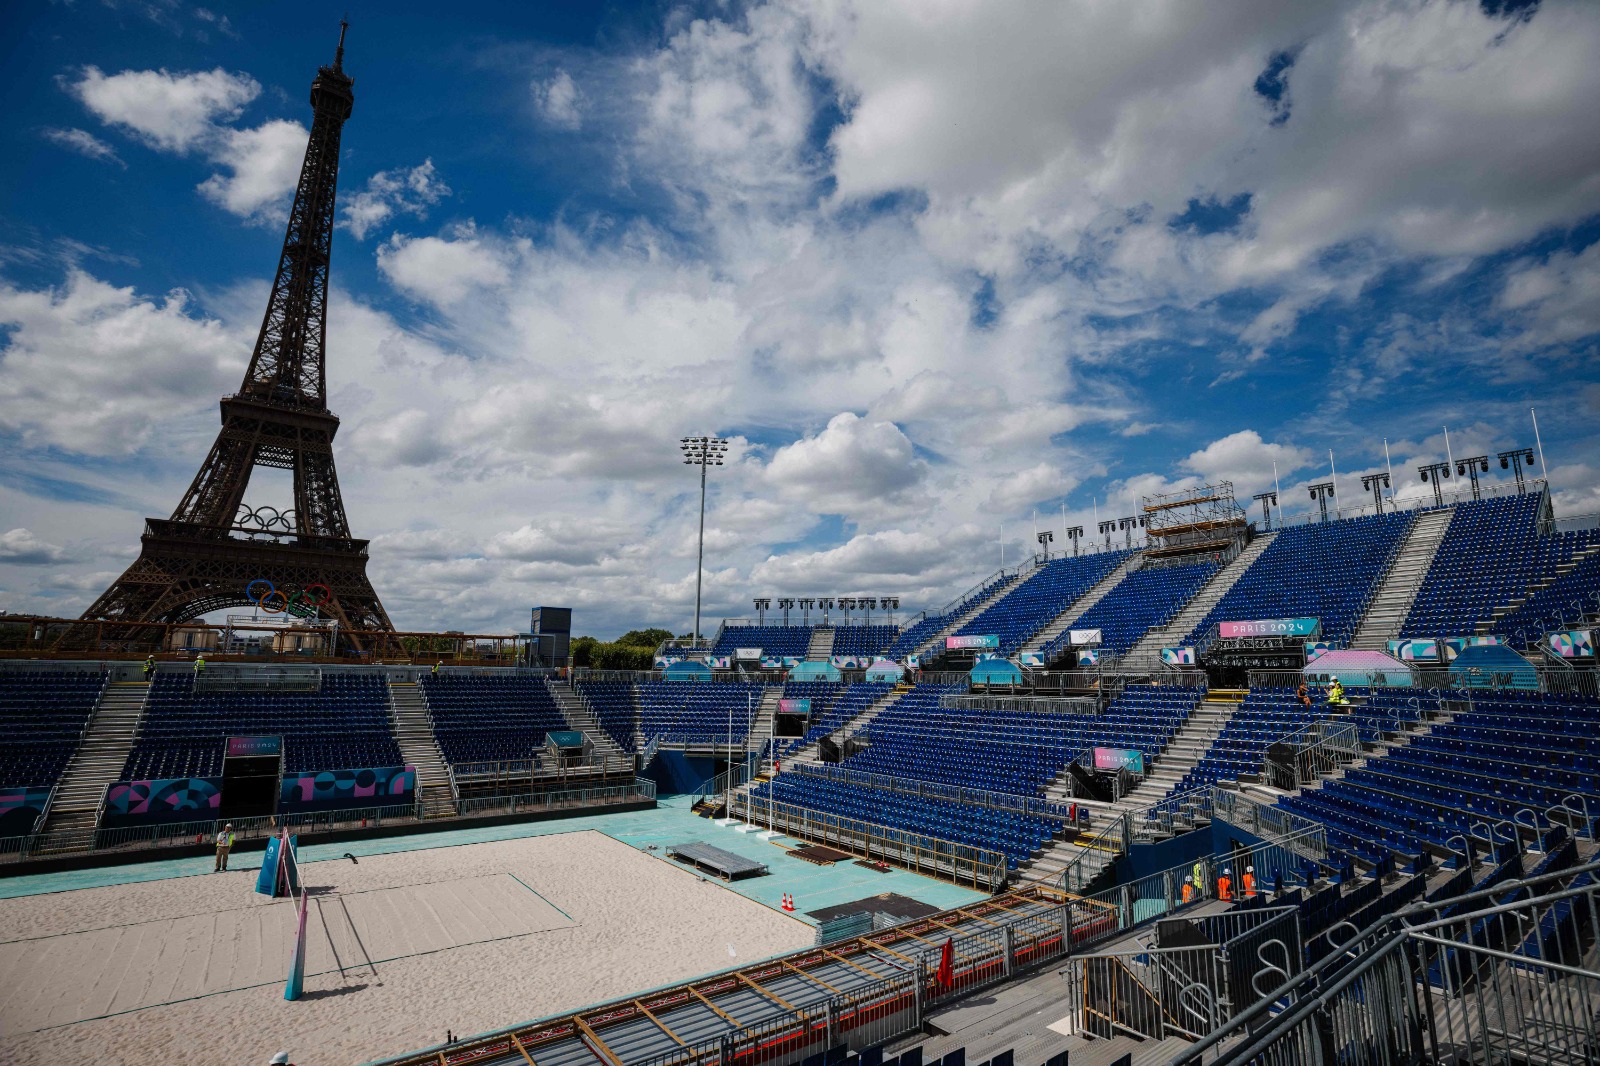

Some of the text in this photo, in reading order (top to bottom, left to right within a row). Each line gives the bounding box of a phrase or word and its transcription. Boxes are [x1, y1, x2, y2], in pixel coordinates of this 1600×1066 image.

[1233, 623, 1304, 633] PARIS 2024
[1097, 754, 1118, 762] PARIS
